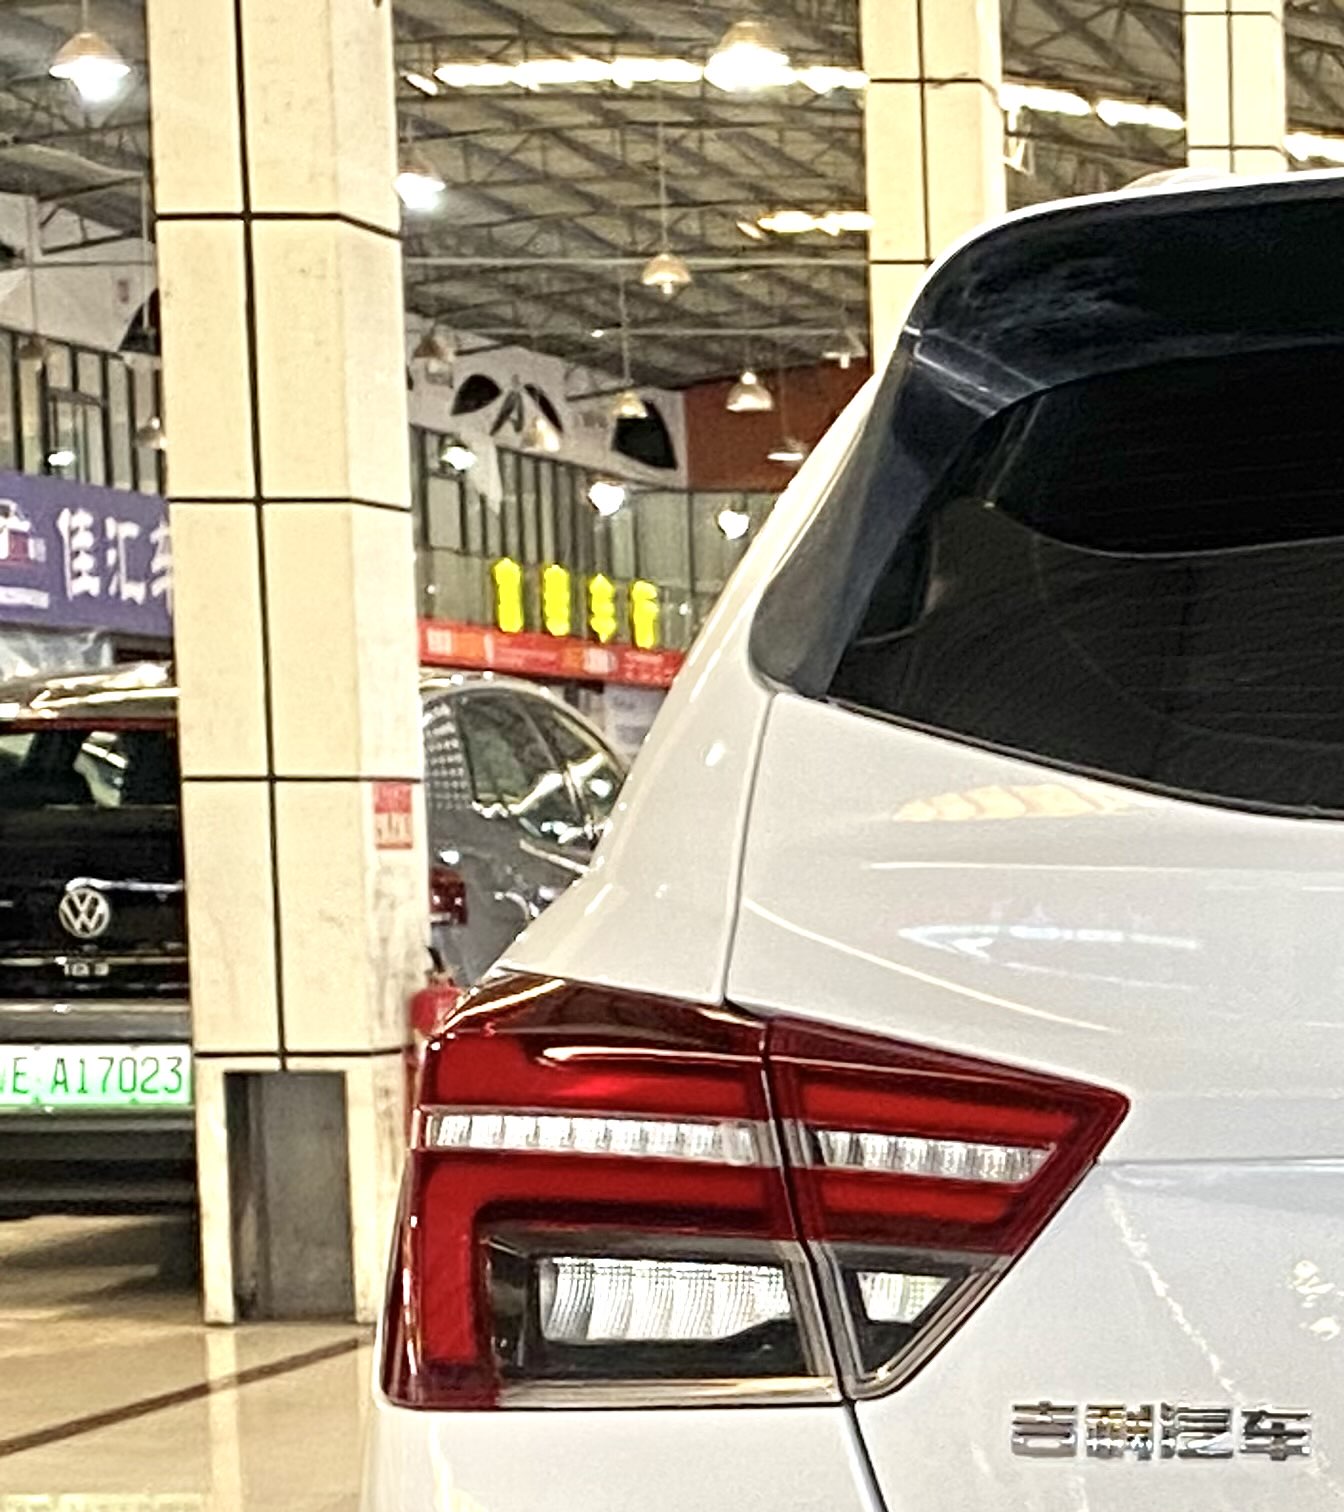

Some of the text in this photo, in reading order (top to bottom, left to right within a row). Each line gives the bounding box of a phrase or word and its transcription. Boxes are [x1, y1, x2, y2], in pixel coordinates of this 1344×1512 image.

[51, 1057, 183, 1094] A17023
[1011, 1400, 1313, 1462] 吉利汽车
